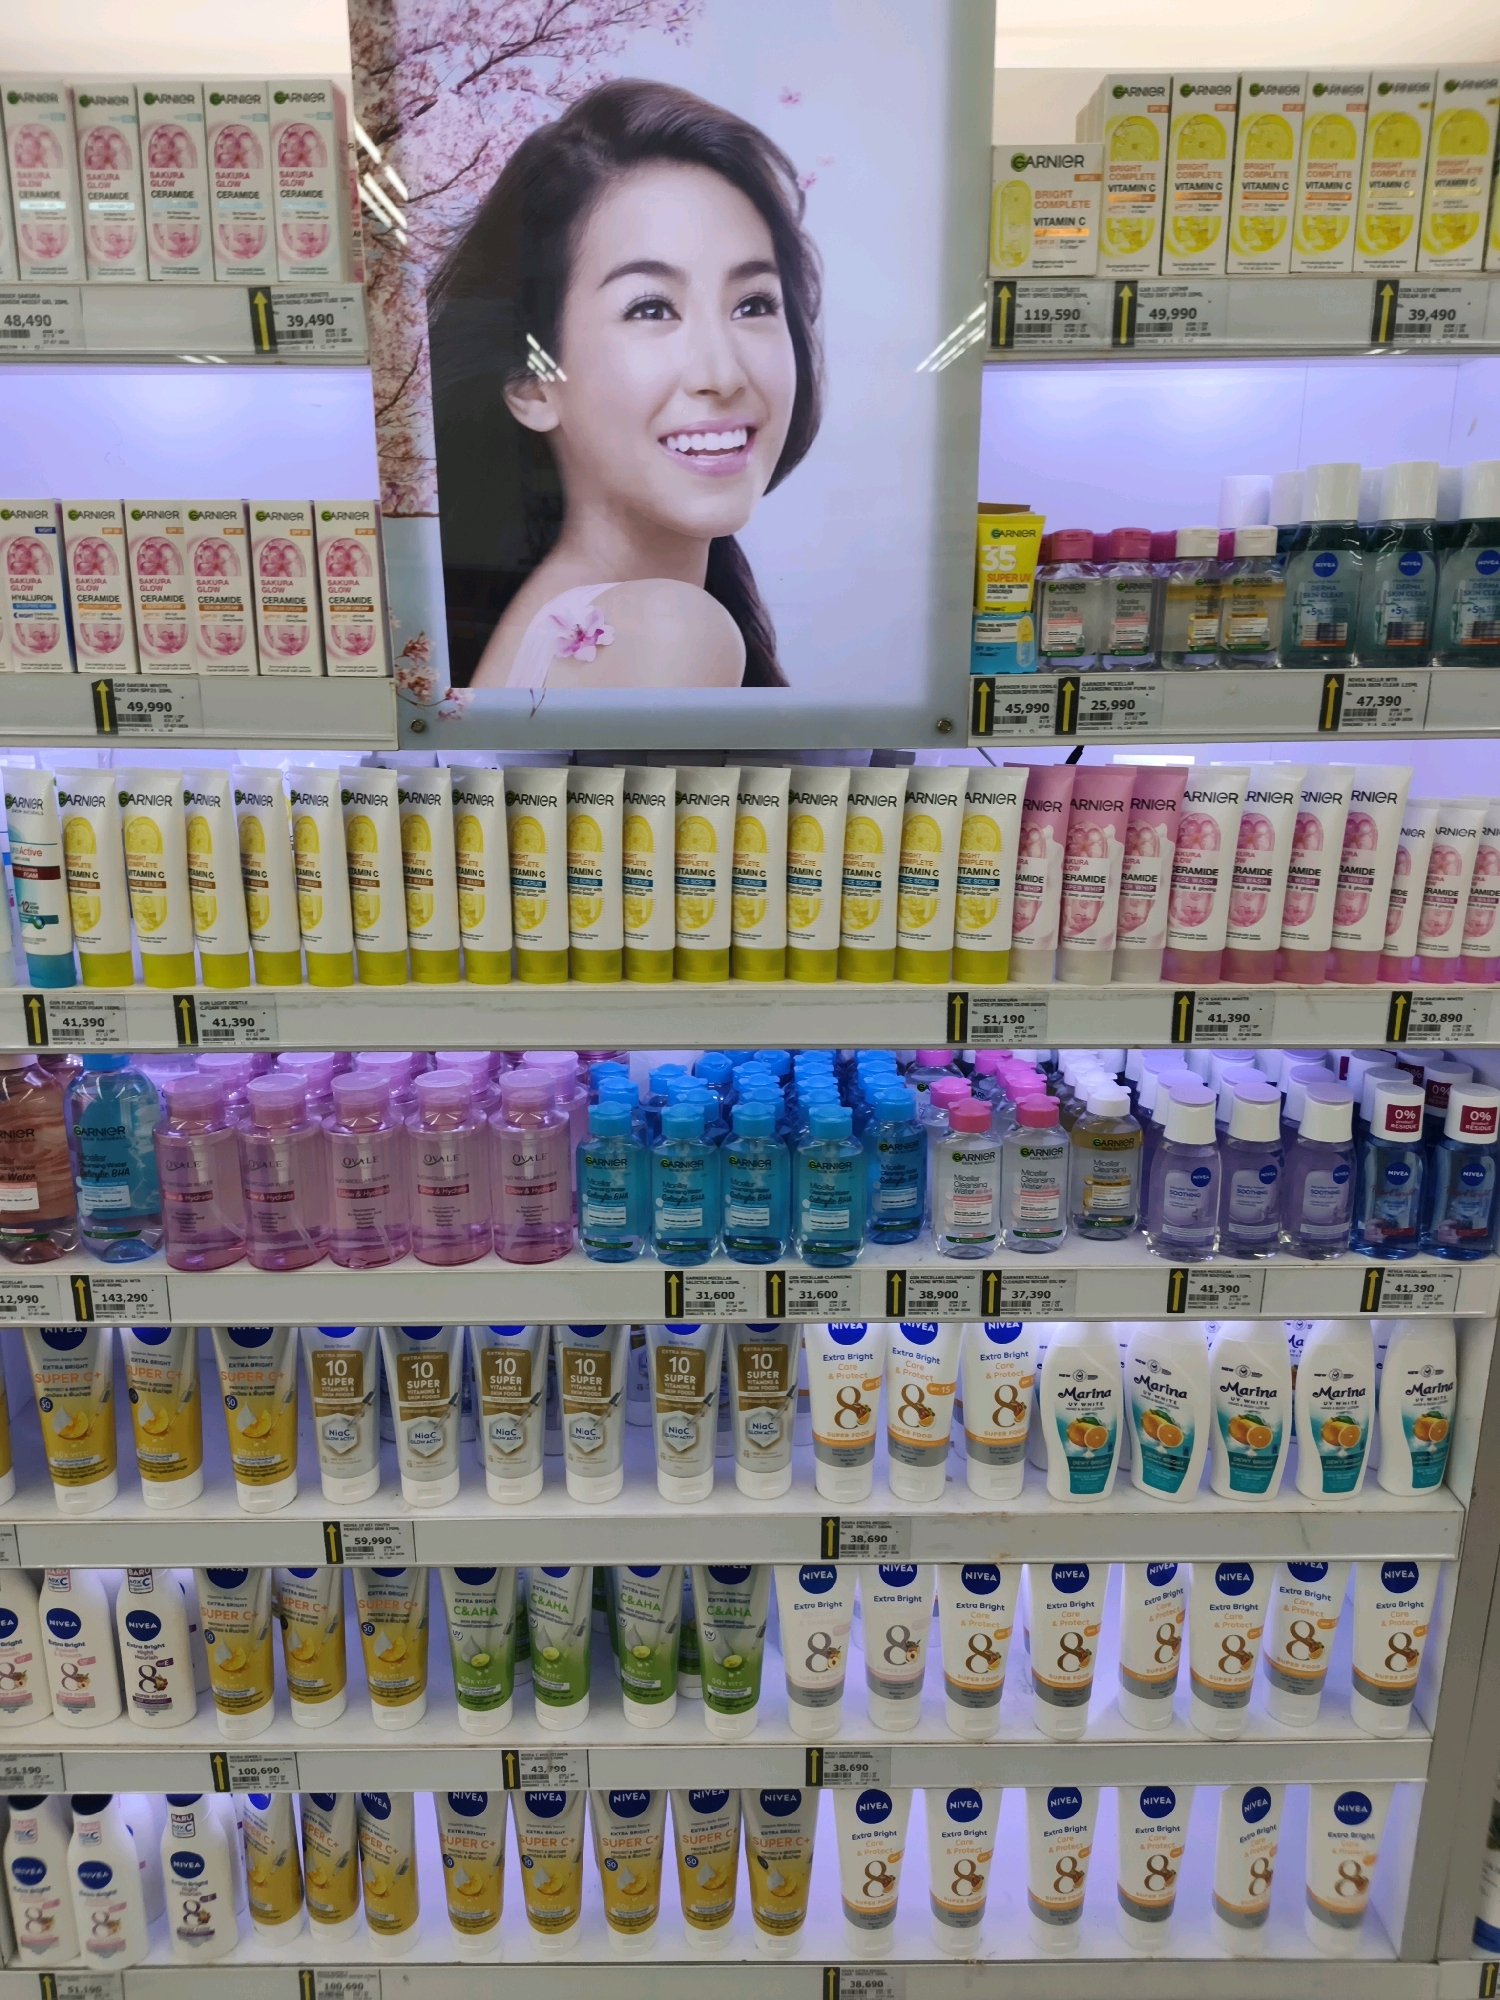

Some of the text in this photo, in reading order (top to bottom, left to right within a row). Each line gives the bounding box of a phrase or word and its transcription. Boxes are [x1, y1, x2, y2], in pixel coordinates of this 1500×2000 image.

[1112, 84, 1165, 99] GARNIER
[1011, 152, 1084, 172] GARNIER
[1109, 164, 1142, 172] BRIGHT
[279, 170, 314, 179] SAKURA
[1108, 172, 1156, 181] COMPLETE
[279, 179, 305, 187] GLOW
[1108, 183, 1156, 193] VITAMIN C
[1175, 182, 1223, 191] VITAMIN C
[1241, 182, 1290, 191] VITAMIN C
[151, 190, 195, 199] CERAMIDE
[279, 190, 324, 199] CERAMIDE
[1034, 190, 1074, 199] BRIGHT
[1034, 200, 1090, 209] COMPLETE
[1034, 216, 1086, 227] VITAMIN C
[1024, 309, 1080, 322] 119,590
[1149, 307, 1197, 322] 49,990
[1408, 308, 1456, 322] 39,490
[4, 314, 52, 328] 48,490
[286, 313, 334, 328] 39,490
[67, 509, 116, 521] GARNIER
[321, 510, 369, 523] GARNIER
[991, 528, 1036, 539] GARNIER
[327, 579, 360, 587] SAKURA
[987, 573, 1032, 583] SUPER UV
[11, 594, 53, 602] HYALURON
[76, 594, 120, 602] CERAMIDE
[328, 596, 372, 605] CERAMIDE
[1091, 699, 1136, 712] 25,990
[1356, 695, 1402, 707] 47,390
[127, 701, 172, 713] 49,990
[1004, 703, 1050, 715] 45,990
[63, 1017, 105, 1028] 41,390
[212, 1017, 255, 1028] 41,390
[983, 1014, 1025, 1025] 51,190
[1207, 1013, 1250, 1023] 41,390
[1421, 1013, 1462, 1024] 30,890
[1394, 1109, 1416, 1120] 0%
[1470, 1111, 1492, 1122] 0%
[1465, 1124, 1493, 1132] RESIDUE
[1020, 1146, 1063, 1158] GARNIER
[342, 1155, 380, 1169] OVALE
[422, 1153, 460, 1166] OVALE
[511, 1153, 547, 1167] OVALE
[1093, 1158, 1120, 1167] Micellar
[1021, 1168, 1049, 1177] Micellar
[953, 1174, 980, 1183] Micellar
[1021, 1176, 1056, 1185] Cleansing
[953, 1181, 988, 1191] Cleansing
[953, 1187, 974, 1195] Water
[1021, 1182, 1042, 1190] Water
[1169, 1189, 1202, 1198] SOOTHING
[1236, 1188, 1268, 1196] SOOTHING
[1310, 1188, 1341, 1196] SOOTHING
[1200, 1284, 1240, 1294] 41,390
[1394, 1284, 1434, 1294] 41,390
[101, 1293, 148, 1303] 143,290
[696, 1291, 735, 1301] 31,600
[799, 1290, 838, 1300] 31,600
[919, 1290, 959, 1300] 38,900
[1011, 1290, 1051, 1300] 37,390
[495, 1358, 517, 1375] 10
[575, 1358, 596, 1375] 10
[668, 1356, 690, 1374] 10
[751, 1354, 773, 1370] 10
[837, 1362, 858, 1371] Care
[995, 1361, 1014, 1370] Care
[325, 1360, 348, 1376] 10
[410, 1362, 434, 1379] 10
[34, 1371, 102, 1385] SUPER C+
[489, 1375, 522, 1385] SUPER
[406, 1380, 440, 1389] SUPER
[1133, 1374, 1188, 1399] Marina
[1405, 1380, 1454, 1397] Marina
[1057, 1386, 1112, 1401] Marina
[1219, 1381, 1278, 1399] Marina
[1312, 1385, 1366, 1400] Marina
[414, 1431, 437, 1439] NiaC
[668, 1426, 690, 1435] NiaC
[354, 1536, 392, 1546] 59,990
[850, 1535, 888, 1544] 38,690
[128, 1568, 151, 1576] BARU
[965, 1571, 997, 1582] NIVEA
[1055, 1570, 1086, 1580] NIVEA
[1219, 1572, 1251, 1582] NIVEA
[530, 1592, 570, 1614] C&AHA
[619, 1592, 661, 1613] C&AHA
[873, 1594, 922, 1603] Extra Bright
[453, 1605, 499, 1616] C&AHA
[706, 1605, 752, 1618] C&AHA
[956, 1602, 1005, 1612] Extra Bright
[1209, 1602, 1259, 1613] Extra Bright
[1224, 1612, 1244, 1621] Care
[1221, 1620, 1253, 1629] Protect
[5, 1766, 42, 1775] 51,190
[238, 1766, 280, 1776] 100,690
[833, 1763, 869, 1773] 38,690
[950, 1800, 980, 1809] NIVEA
[1050, 1796, 1079, 1807] NIVEA
[1143, 1796, 1173, 1806] NIVEA
[859, 1802, 889, 1811] NIVEA
[851, 1830, 898, 1840] Extra Bright
[941, 1829, 988, 1839] Extra Bright
[602, 1836, 642, 1848] SUPER
[951, 1859, 977, 1897] 8
[1053, 1856, 1079, 1894] 8
[325, 1982, 364, 1991] 100,690
[850, 1980, 884, 1989] 38,690
